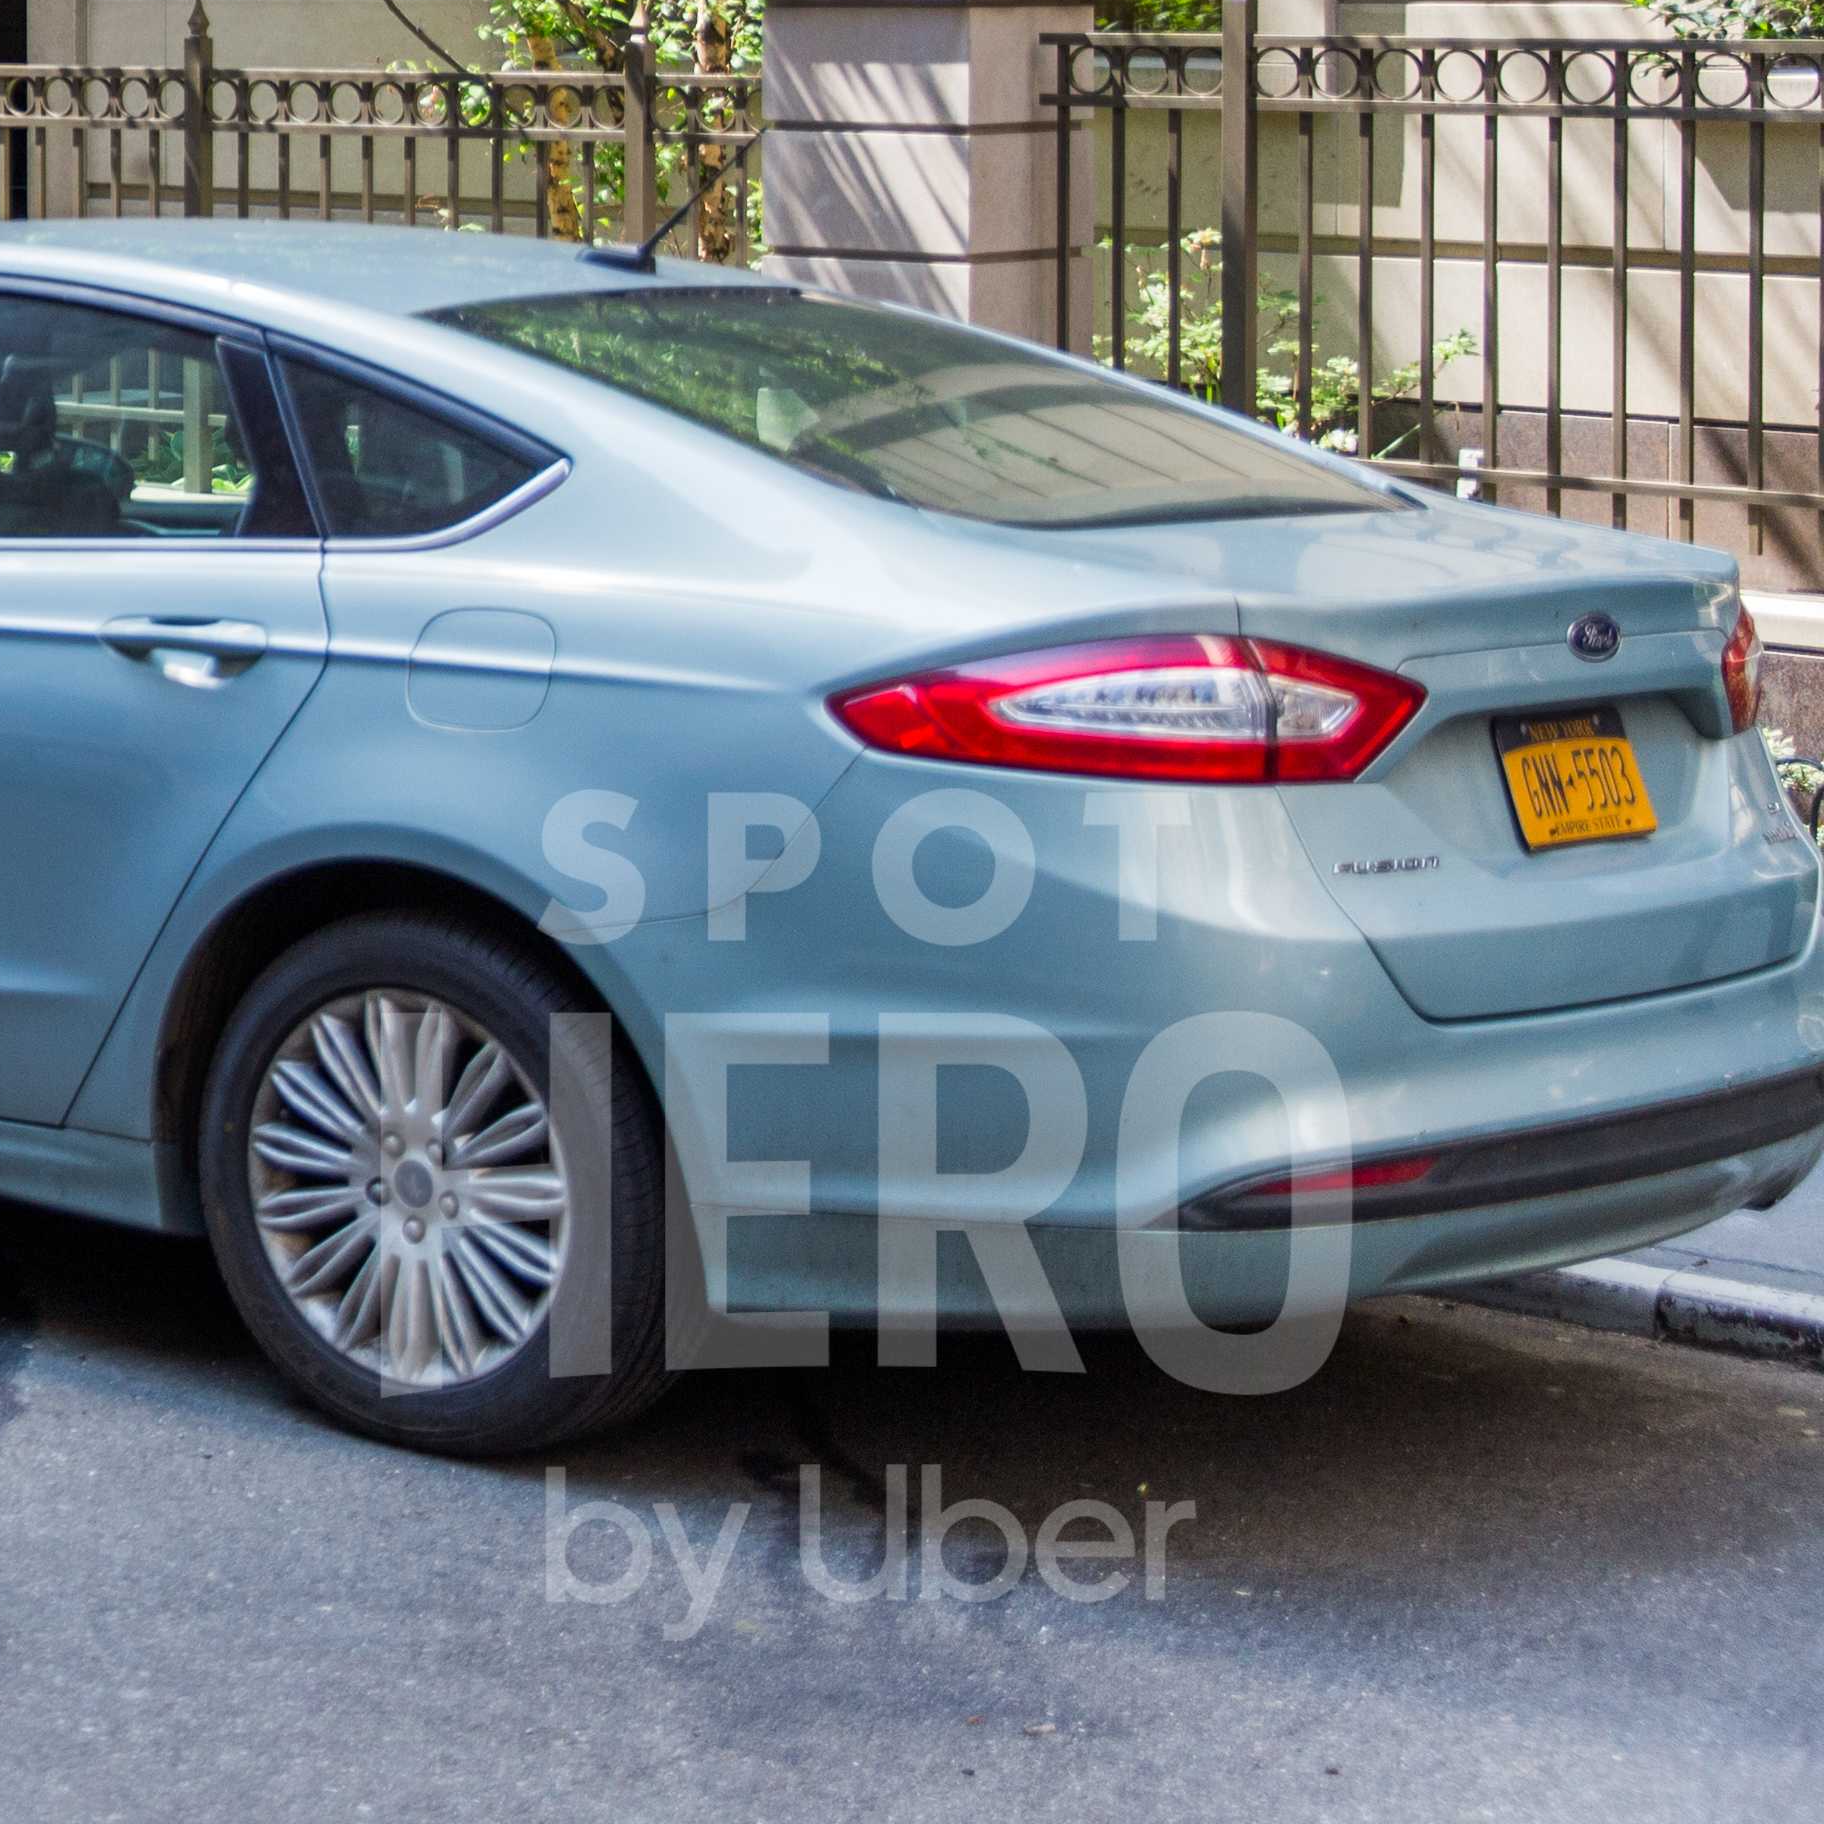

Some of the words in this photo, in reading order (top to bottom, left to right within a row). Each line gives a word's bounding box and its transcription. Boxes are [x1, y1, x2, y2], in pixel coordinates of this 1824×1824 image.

[1526, 723, 1556, 743] NEW
[1559, 719, 1595, 740] YORK
[1555, 820, 1591, 836] EMPIRE
[1593, 816, 1623, 832] STATE
